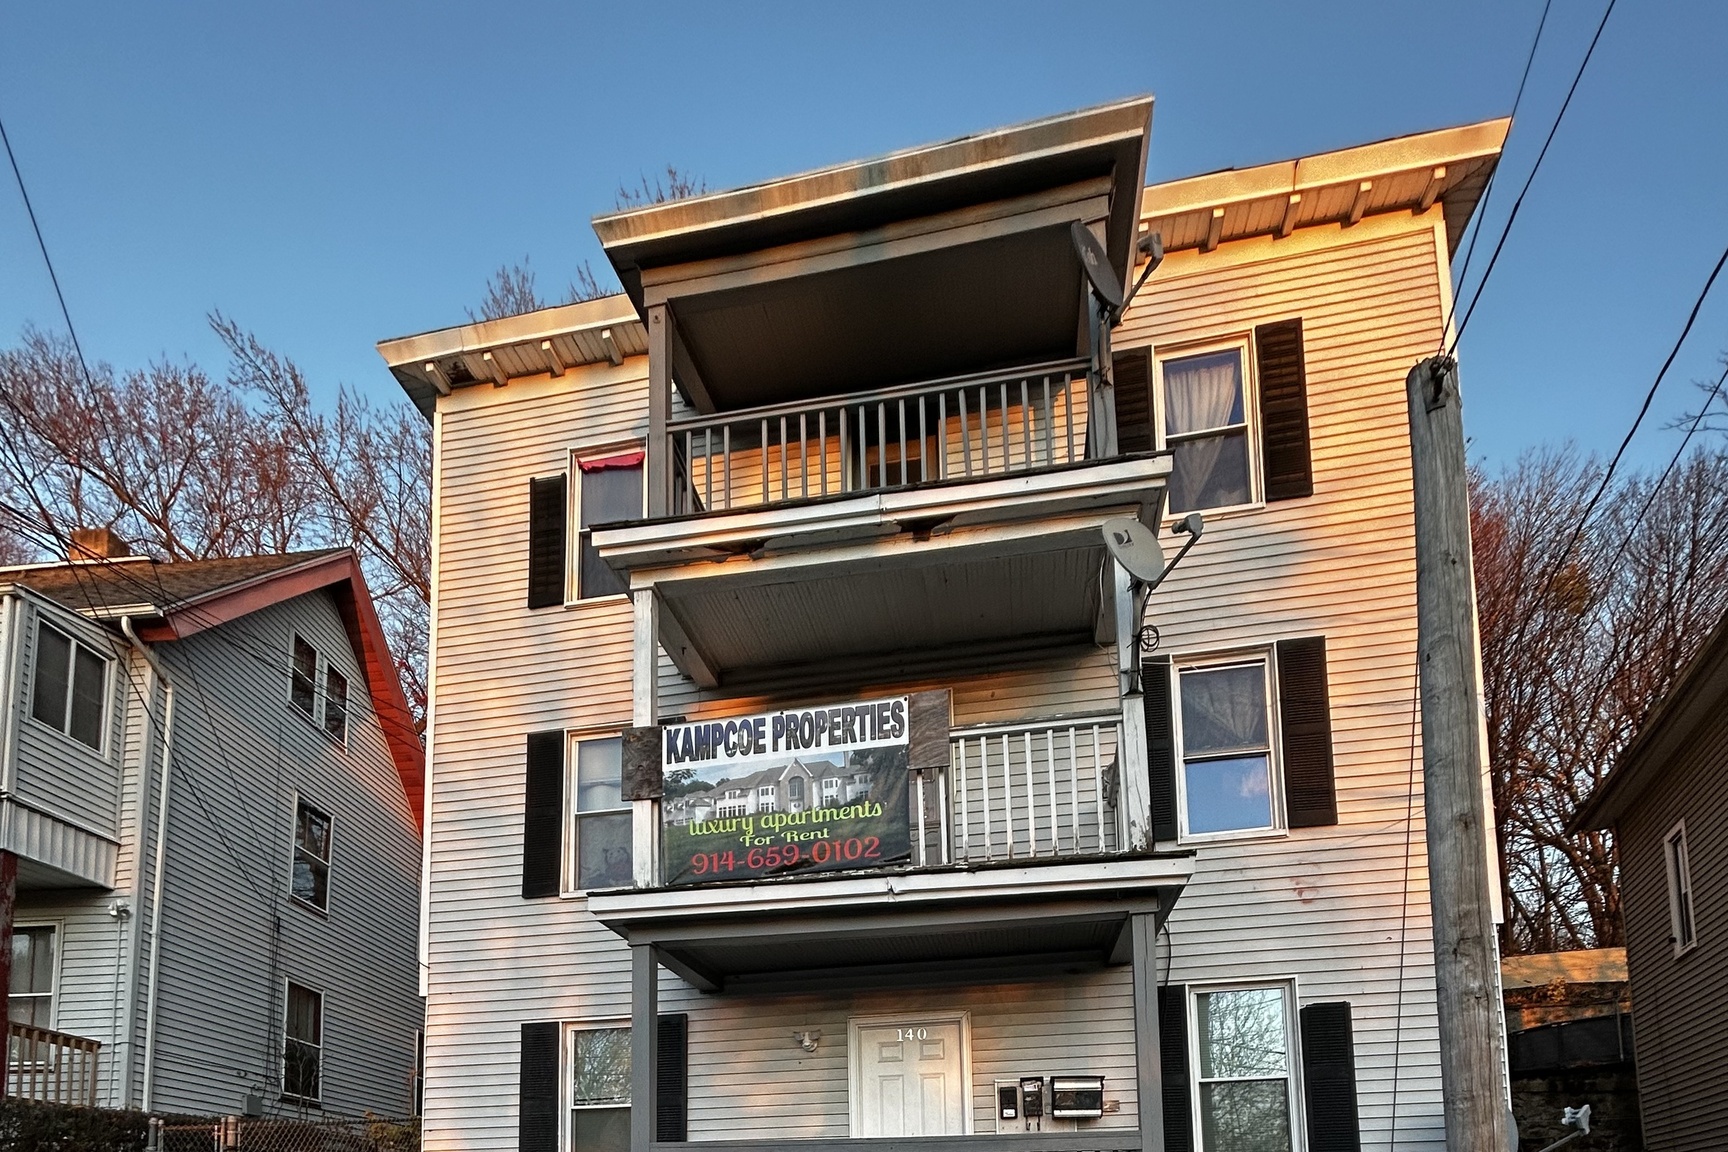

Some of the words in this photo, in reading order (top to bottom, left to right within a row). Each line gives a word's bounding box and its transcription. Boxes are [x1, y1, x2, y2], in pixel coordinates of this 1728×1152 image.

[666, 717, 767, 765] KAMPCOE
[772, 700, 906, 752] PROPERTIES
[689, 816, 754, 836] luxury
[760, 800, 883, 833] apartments
[739, 833, 775, 847] For
[780, 827, 831, 843] Rent
[691, 836, 882, 876] 914-659-0102
[896, 1027, 927, 1042] 140
